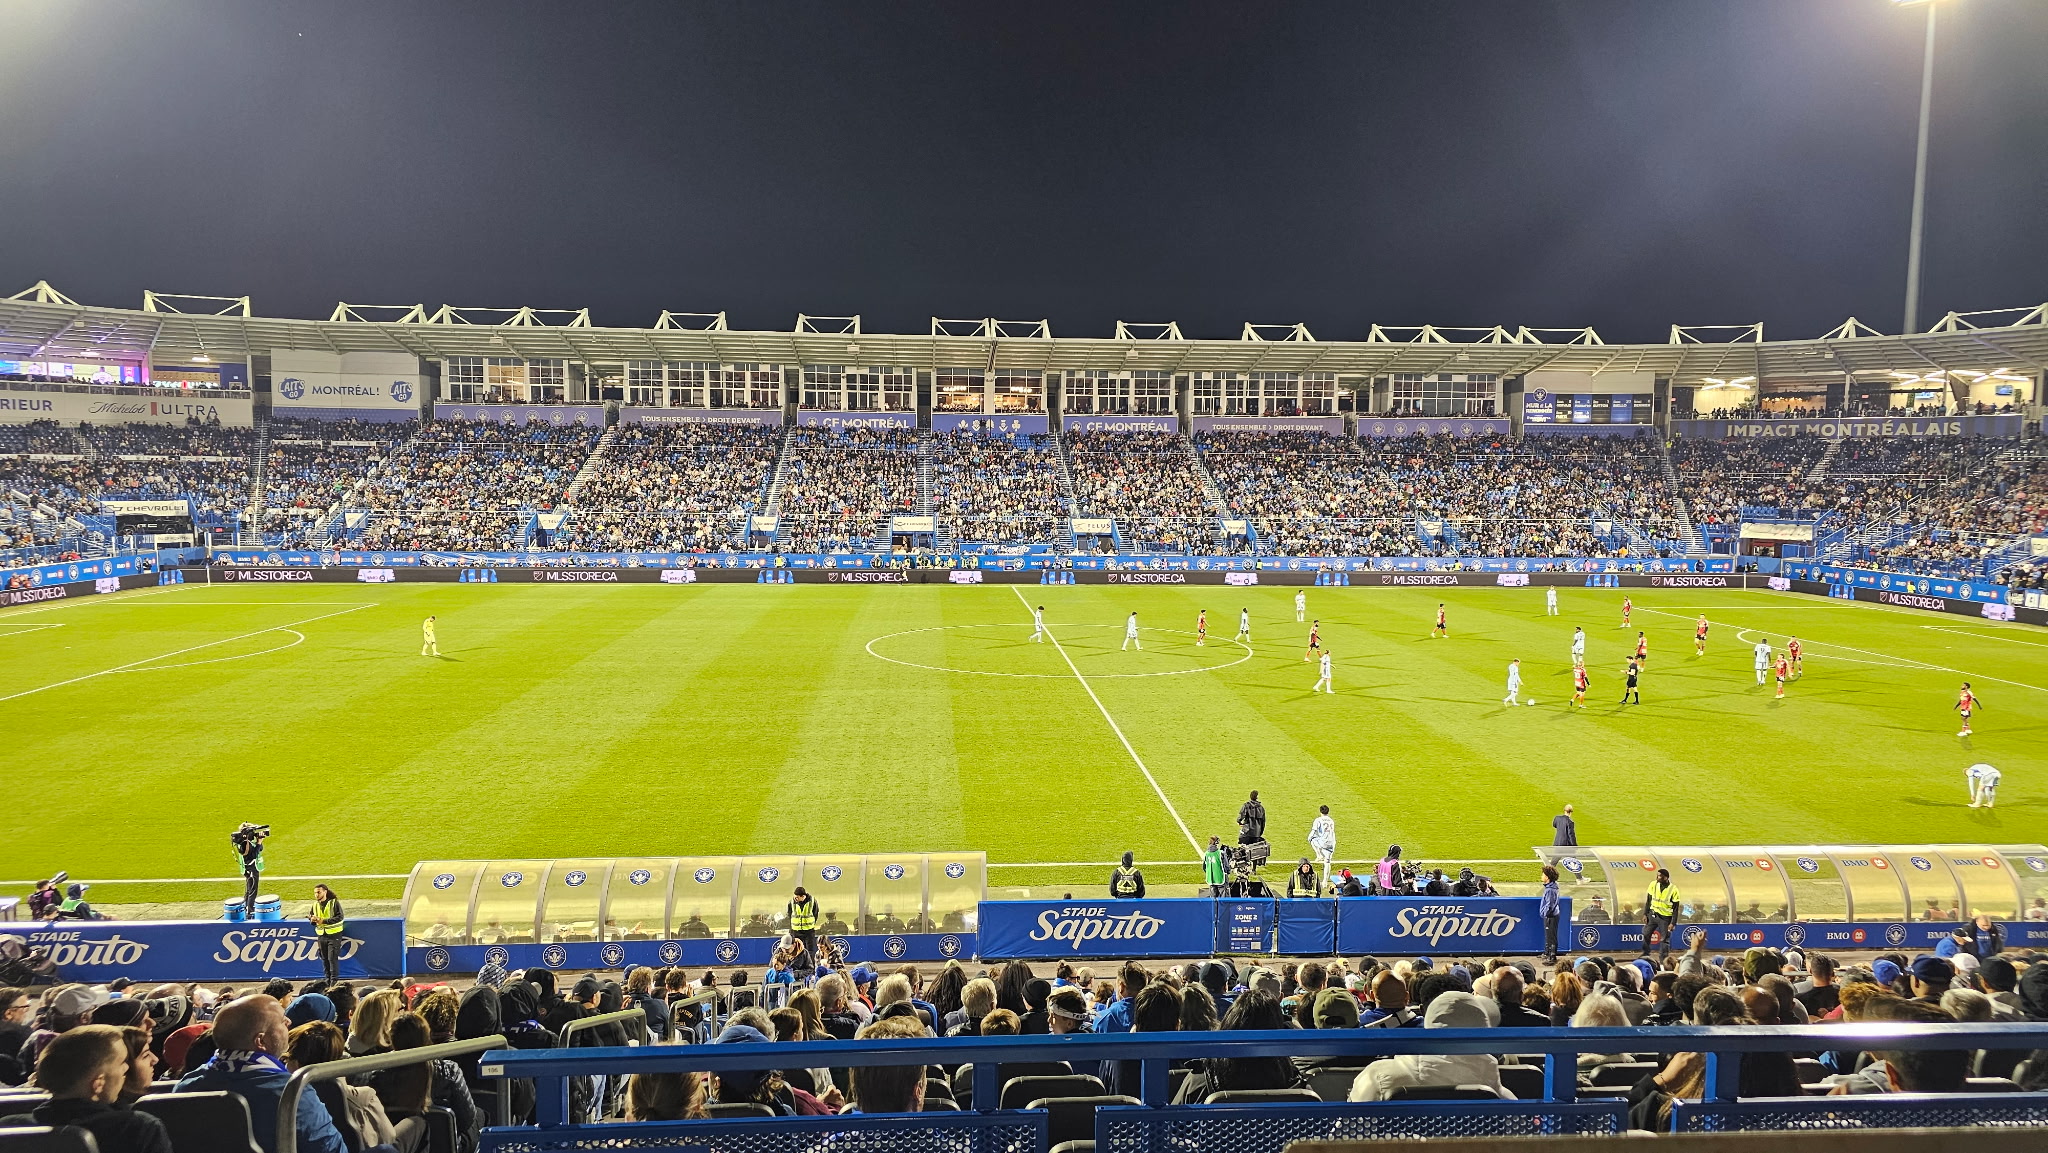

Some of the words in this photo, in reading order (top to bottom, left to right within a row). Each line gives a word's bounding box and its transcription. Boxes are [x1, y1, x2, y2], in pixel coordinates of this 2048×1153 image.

[312, 384, 379, 396] MONTRÉAL!
[88, 401, 147, 414] Michelob
[161, 403, 218, 416] ULTRA
[823, 418, 839, 428] CF
[842, 417, 910, 428] MONTRÉAL
[1086, 422, 1102, 431] CF
[1104, 420, 1170, 432] MONTRÉAL
[1727, 424, 1799, 437] IMPACT
[1806, 421, 1961, 437] MONTRÉALAIS
[1609, 861, 1637, 869] BMO
[1726, 860, 1753, 868] BMO
[1842, 859, 1868, 867] BMO
[1953, 858, 1980, 866] BMO
[1061, 907, 1107, 917] STADE
[1420, 905, 1464, 915] STADE
[249, 927, 299, 938] STADE
[1029, 910, 1165, 950] Saputo
[1388, 907, 1522, 947] Saputo
[28, 931, 81, 942] STADE
[1621, 934, 1644, 942] BMO
[1724, 933, 1748, 941] BMO
[1827, 932, 1850, 940] BMO
[1927, 931, 1950, 939] BMO
[213, 930, 365, 973] Sapuo
